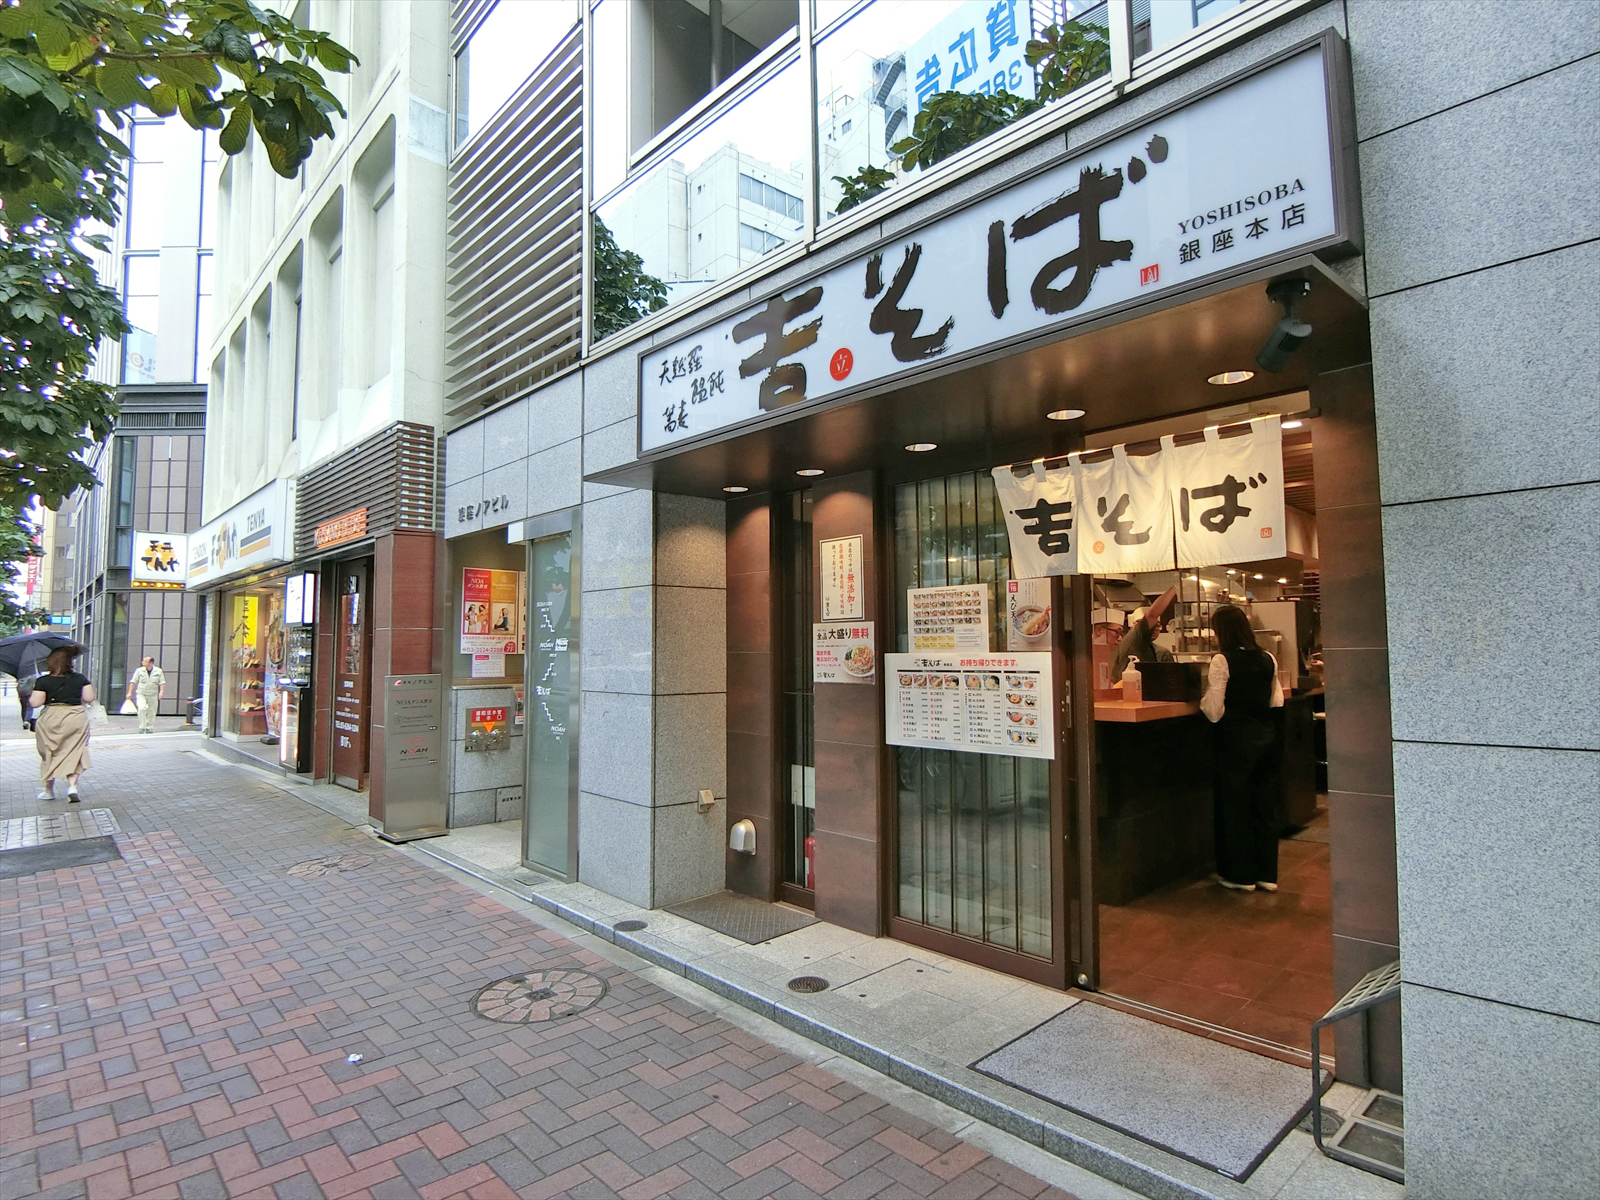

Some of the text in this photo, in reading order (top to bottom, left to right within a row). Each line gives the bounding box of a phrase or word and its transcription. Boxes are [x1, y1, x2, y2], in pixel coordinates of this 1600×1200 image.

[1177, 178, 1306, 235] YOSHISOBA
[1178, 202, 1306, 265] 銀座本店
[732, 133, 1169, 411] 吉そば
[1014, 472, 1268, 557] 吉そば
[140, 556, 180, 572] てんや
[149, 540, 174, 553] 天丼
[400, 747, 428, 756] NOAH
